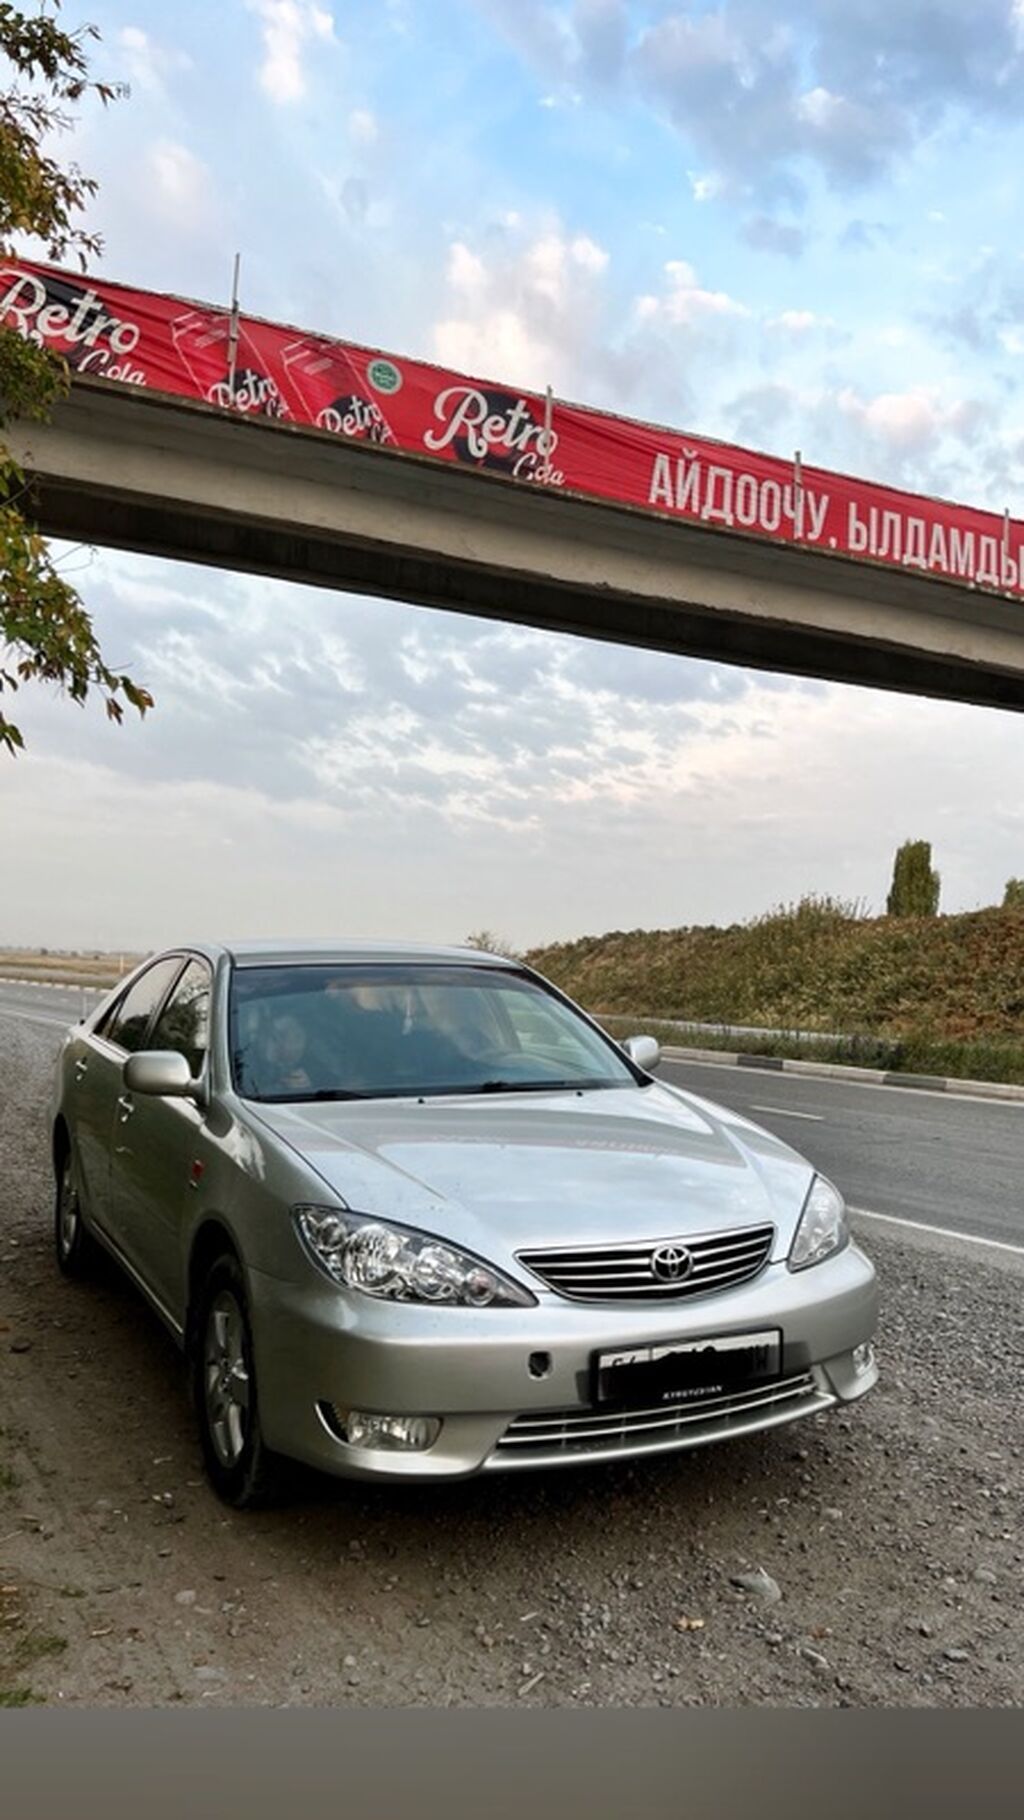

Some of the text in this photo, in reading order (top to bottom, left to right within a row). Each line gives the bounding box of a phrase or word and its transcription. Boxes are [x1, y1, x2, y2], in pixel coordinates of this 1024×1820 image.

[0, 268, 140, 354] Retro
[77, 350, 147, 386] Cola
[424, 386, 558, 458] Retro
[512, 452, 565, 486] Cola
